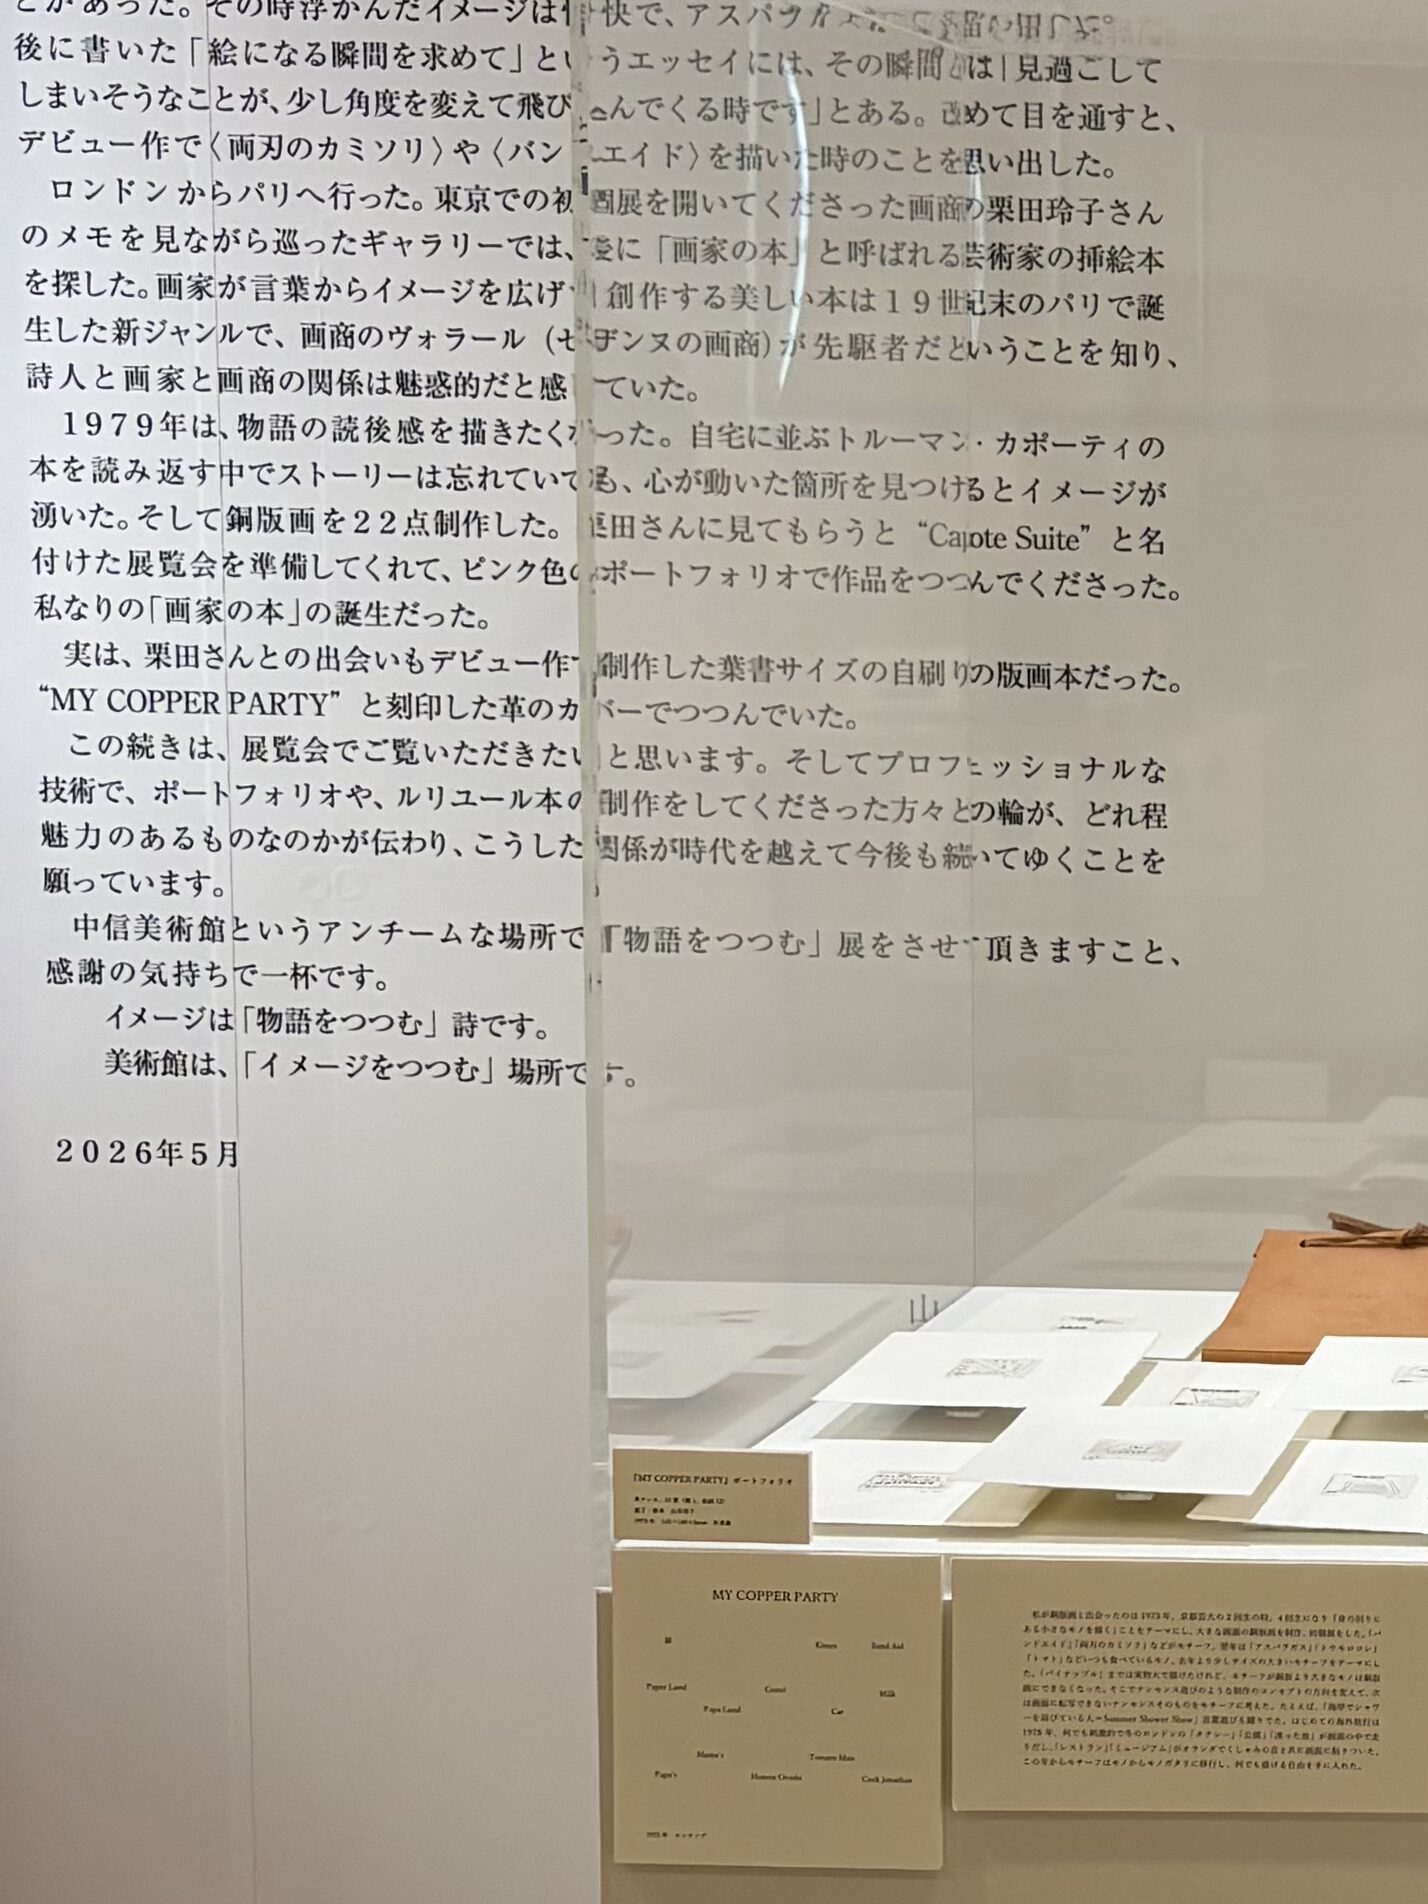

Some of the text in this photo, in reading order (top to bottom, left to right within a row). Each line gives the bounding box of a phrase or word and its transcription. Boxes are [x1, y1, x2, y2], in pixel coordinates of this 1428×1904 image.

[25, 361, 698, 403] 詩人と画家と画商の関係は魅惑的だと感ていた。
[1112, 525, 1165, 556] と名
[33, 592, 489, 631] 私なりの「画家の本」の誕生だった。
[106, 688, 222, 716] COPPER
[43, 866, 224, 899] 願っています。
[45, 956, 387, 994] 感謝の気持ちで一杯です。
[712, 1589, 839, 1604] MY COPPER PARTY
